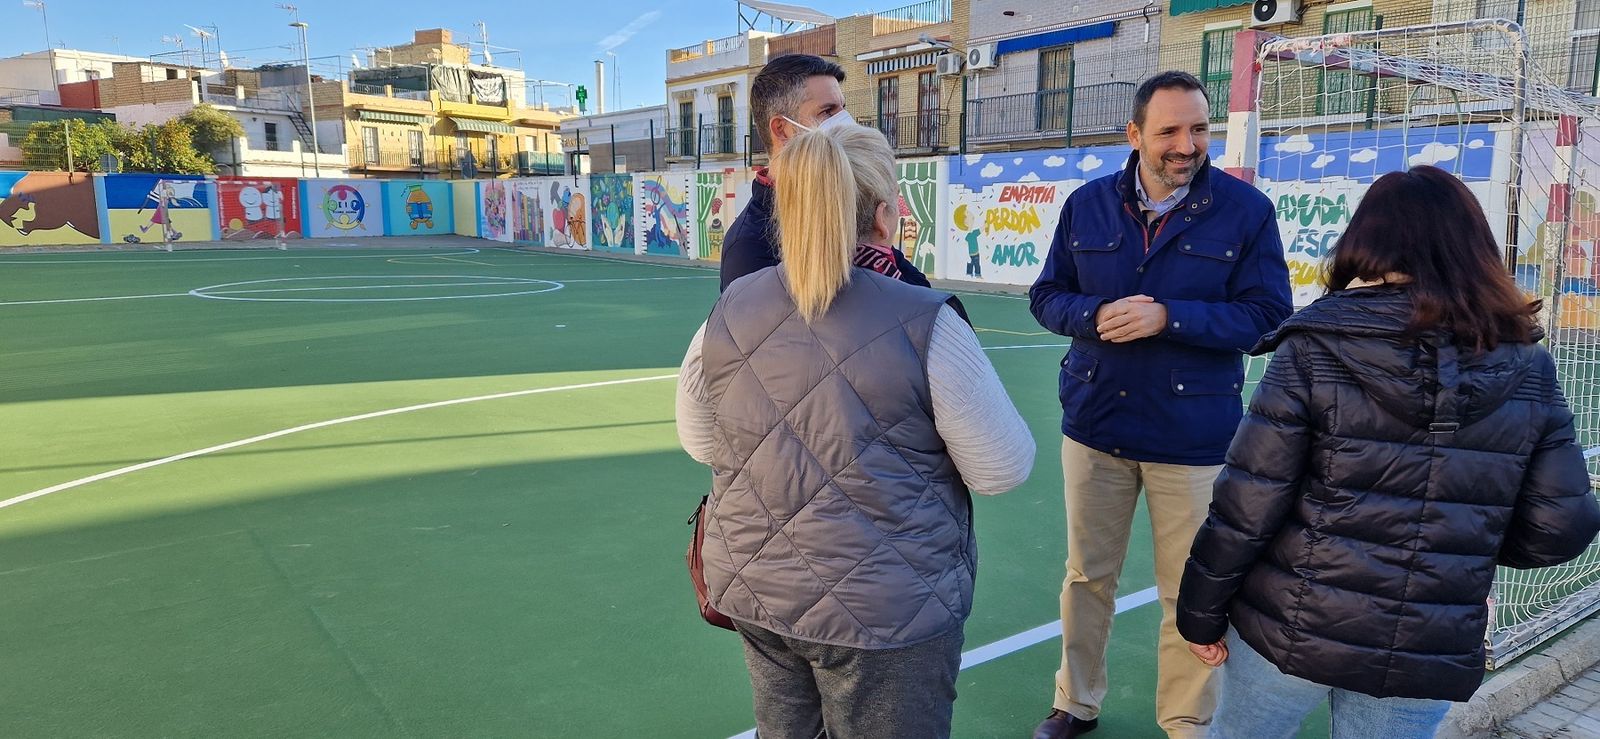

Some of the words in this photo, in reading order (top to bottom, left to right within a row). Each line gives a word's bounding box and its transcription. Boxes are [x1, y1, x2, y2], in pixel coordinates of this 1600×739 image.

[1276, 193, 1352, 227] AYUDA
[991, 242, 1040, 267] AMOR
[1288, 228, 1340, 258] ESC
